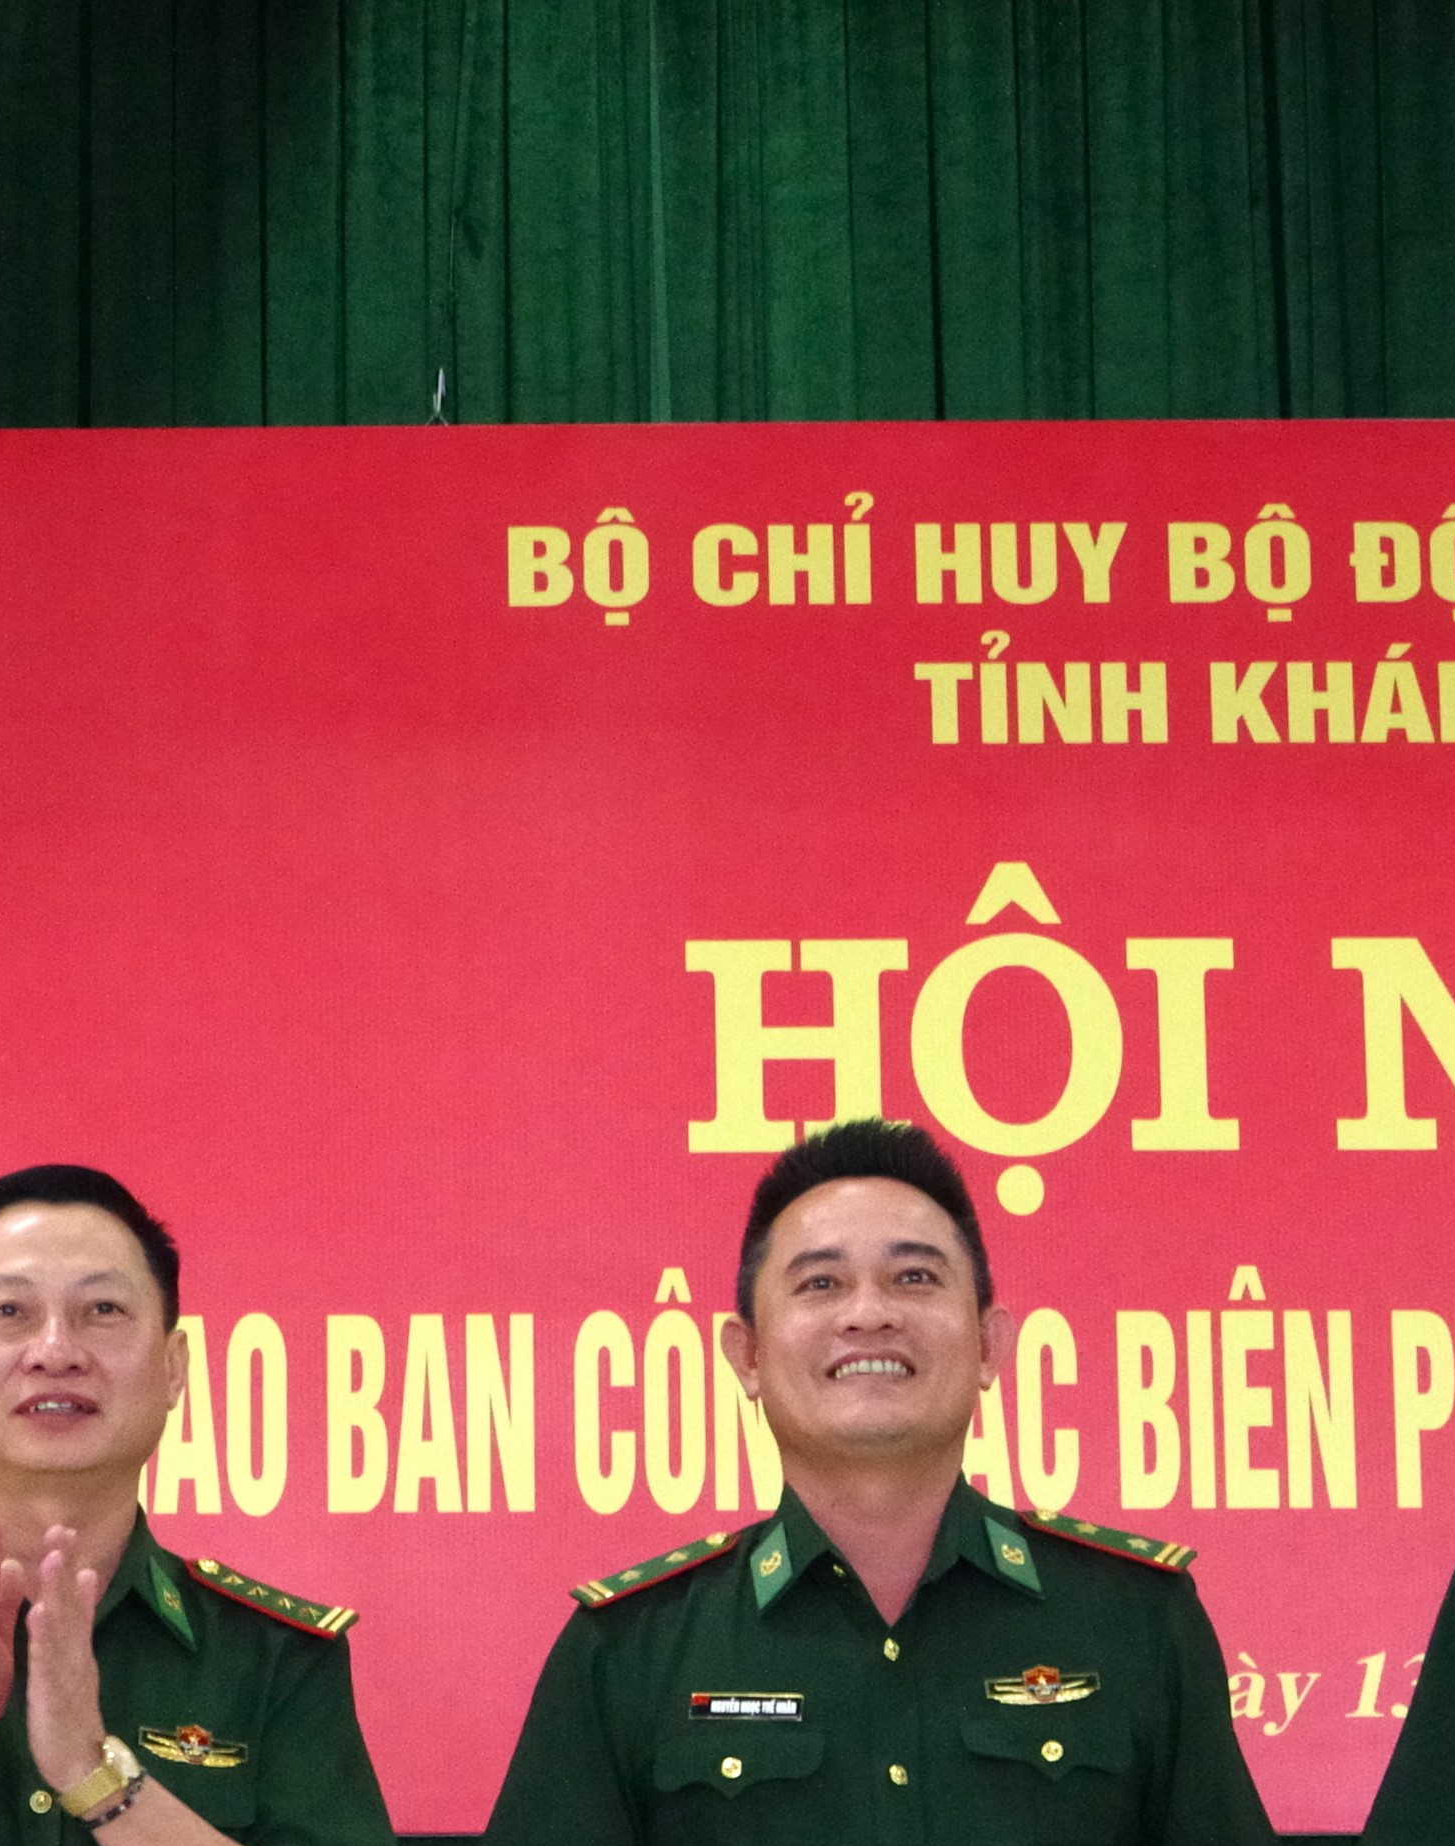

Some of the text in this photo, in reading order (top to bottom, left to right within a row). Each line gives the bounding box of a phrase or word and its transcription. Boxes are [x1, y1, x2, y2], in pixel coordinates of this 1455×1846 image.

[507, 507, 650, 626] BỘ
[692, 492, 874, 606] CHỈ
[915, 523, 1127, 605] HUY
[1168, 504, 1311, 622] BỘ
[914, 630, 1168, 744] TỈNH
[684, 862, 1240, 1216] HỘI
[138, 1311, 289, 1517] AO
[326, 1313, 536, 1514] BAN
[573, 1267, 784, 1516] CÔN
[1115, 1264, 1358, 1510] BIÊN
